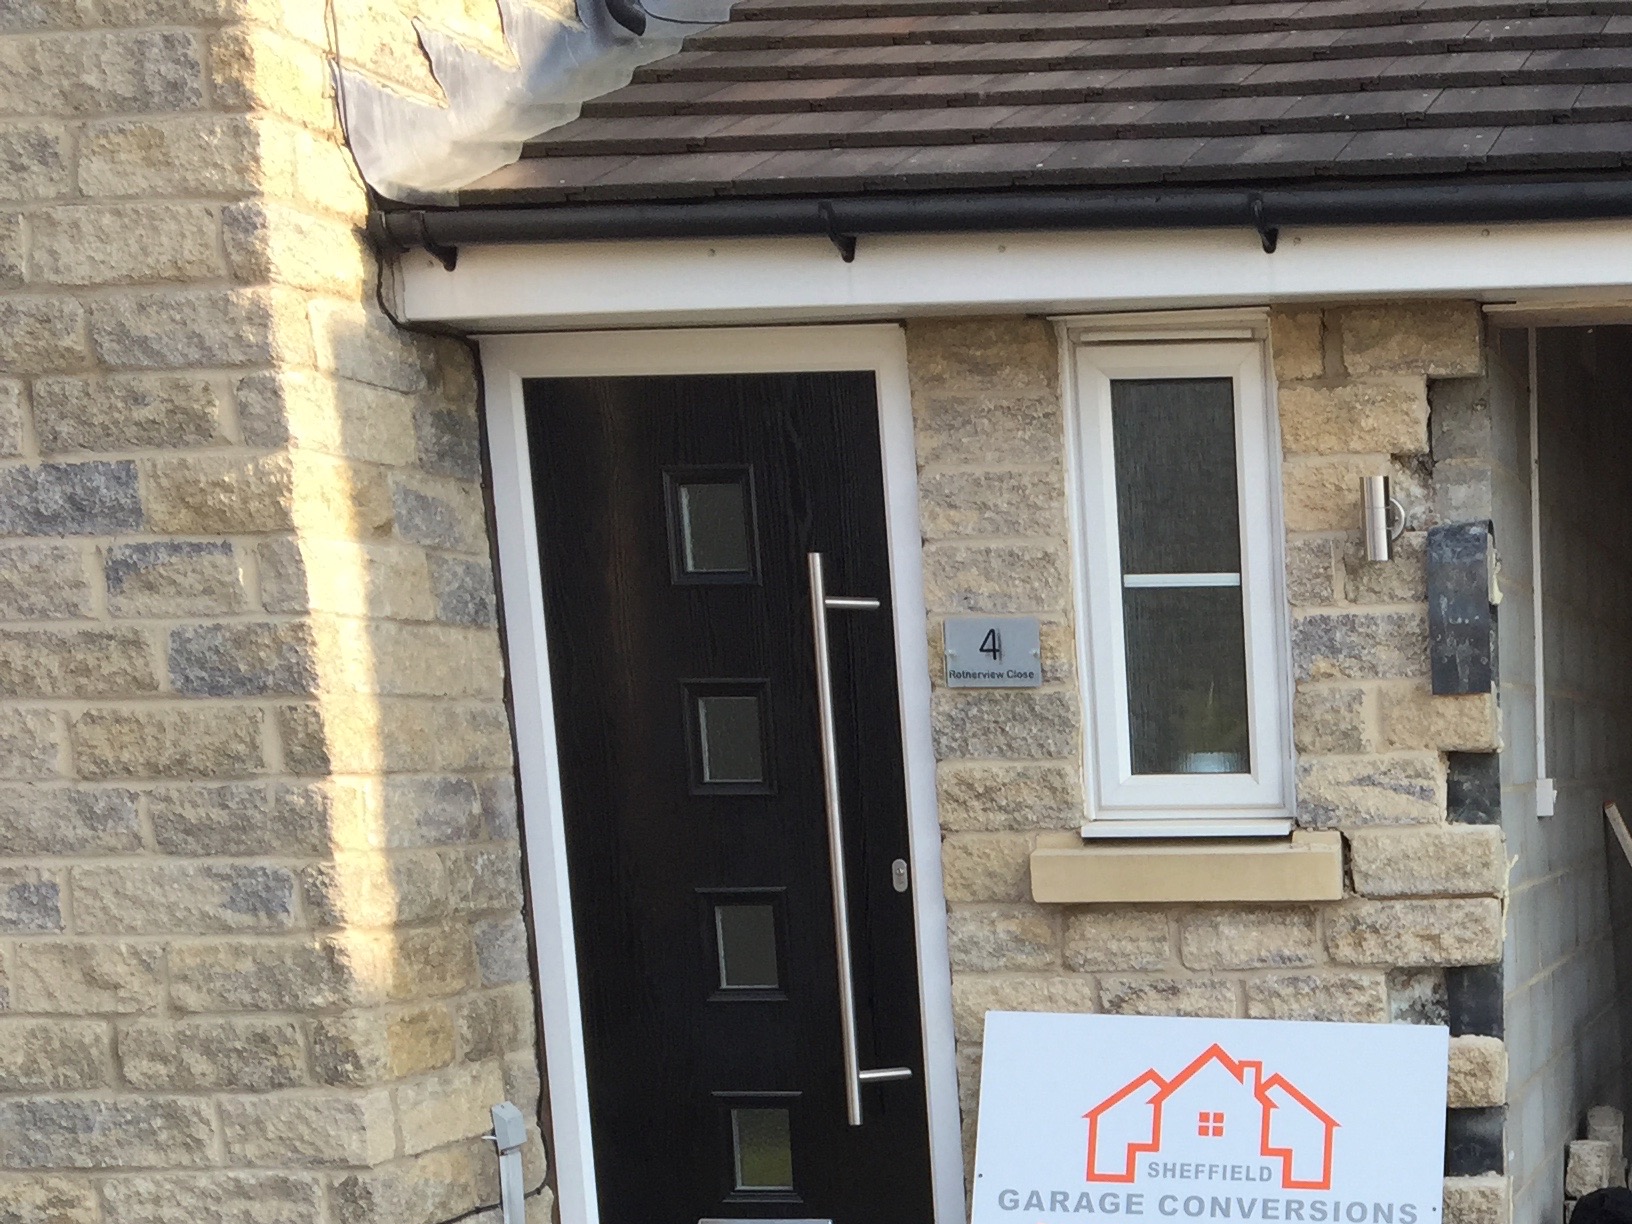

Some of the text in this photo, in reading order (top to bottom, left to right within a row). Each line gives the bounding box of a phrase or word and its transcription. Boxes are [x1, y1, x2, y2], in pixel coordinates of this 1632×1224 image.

[979, 628, 1000, 660] 4
[1006, 669, 1035, 679] Close
[1147, 1161, 1274, 1182] SHEFFIELD
[998, 1189, 1418, 1224] GARAGE CONVERSIONS
